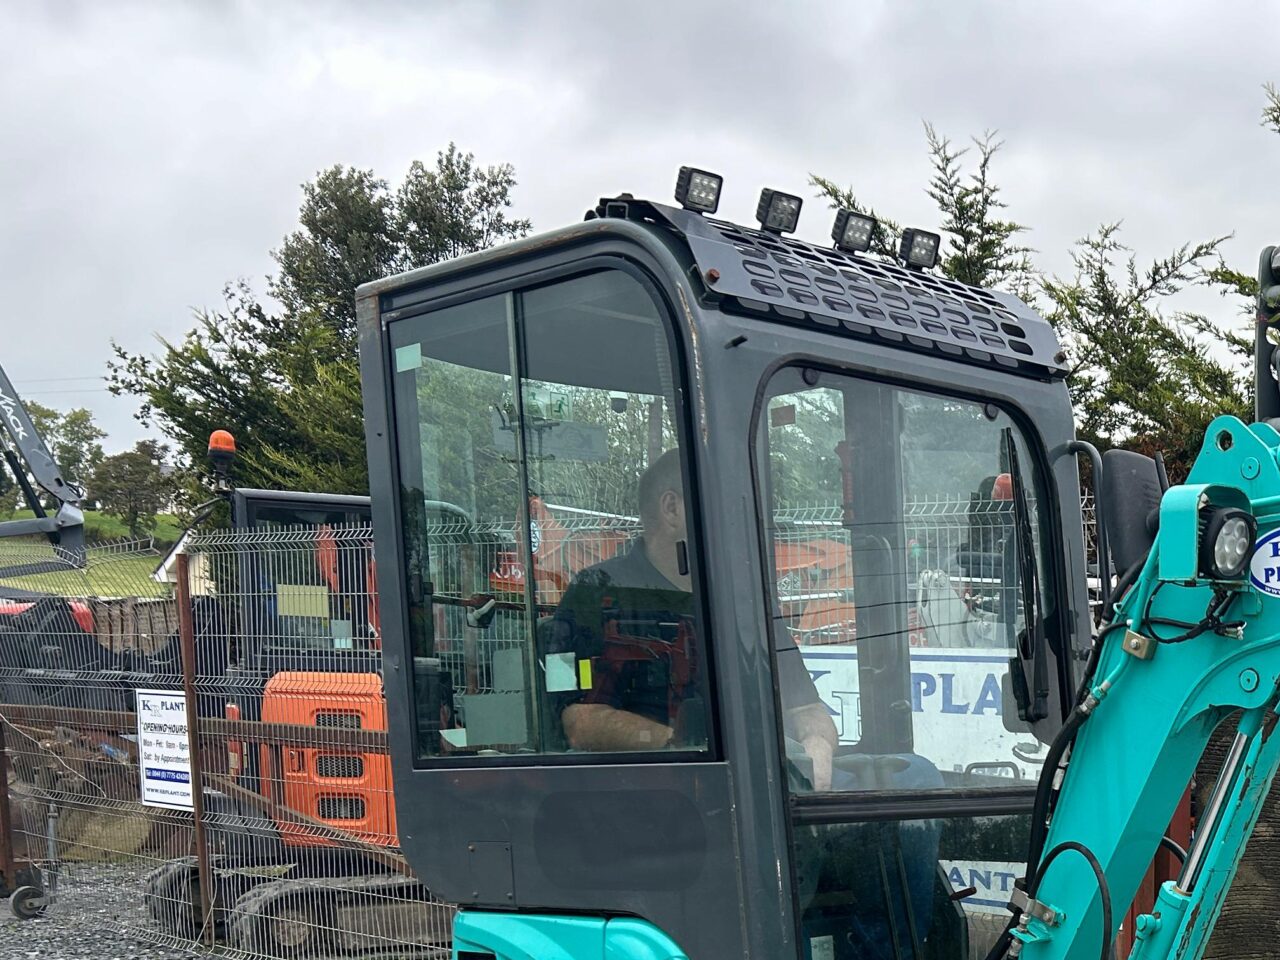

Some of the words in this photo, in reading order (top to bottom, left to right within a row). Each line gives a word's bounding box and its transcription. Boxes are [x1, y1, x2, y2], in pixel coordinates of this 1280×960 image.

[911, 672, 1002, 715] PLA
[161, 701, 185, 711] PLANT
[143, 722, 167, 733] OPENING
[168, 724, 187, 734] HOURS
[948, 866, 1016, 892] ANT
